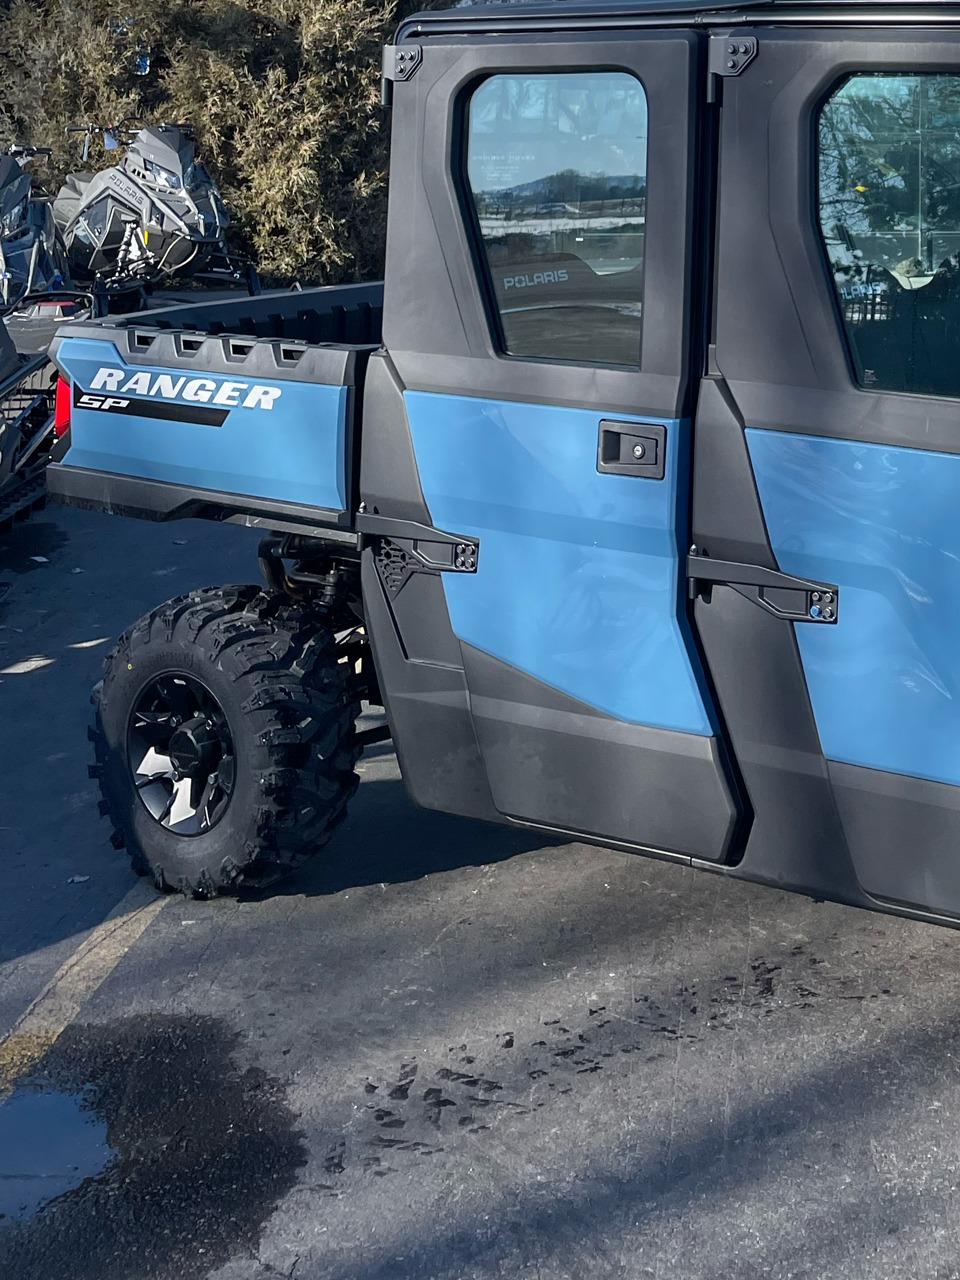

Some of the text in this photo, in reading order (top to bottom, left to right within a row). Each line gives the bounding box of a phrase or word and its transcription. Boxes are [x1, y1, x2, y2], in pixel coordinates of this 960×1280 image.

[109, 173, 144, 205] POLARIS
[503, 269, 569, 290] POLARIS
[89, 367, 282, 410] RANGER
[76, 395, 130, 410] SP
